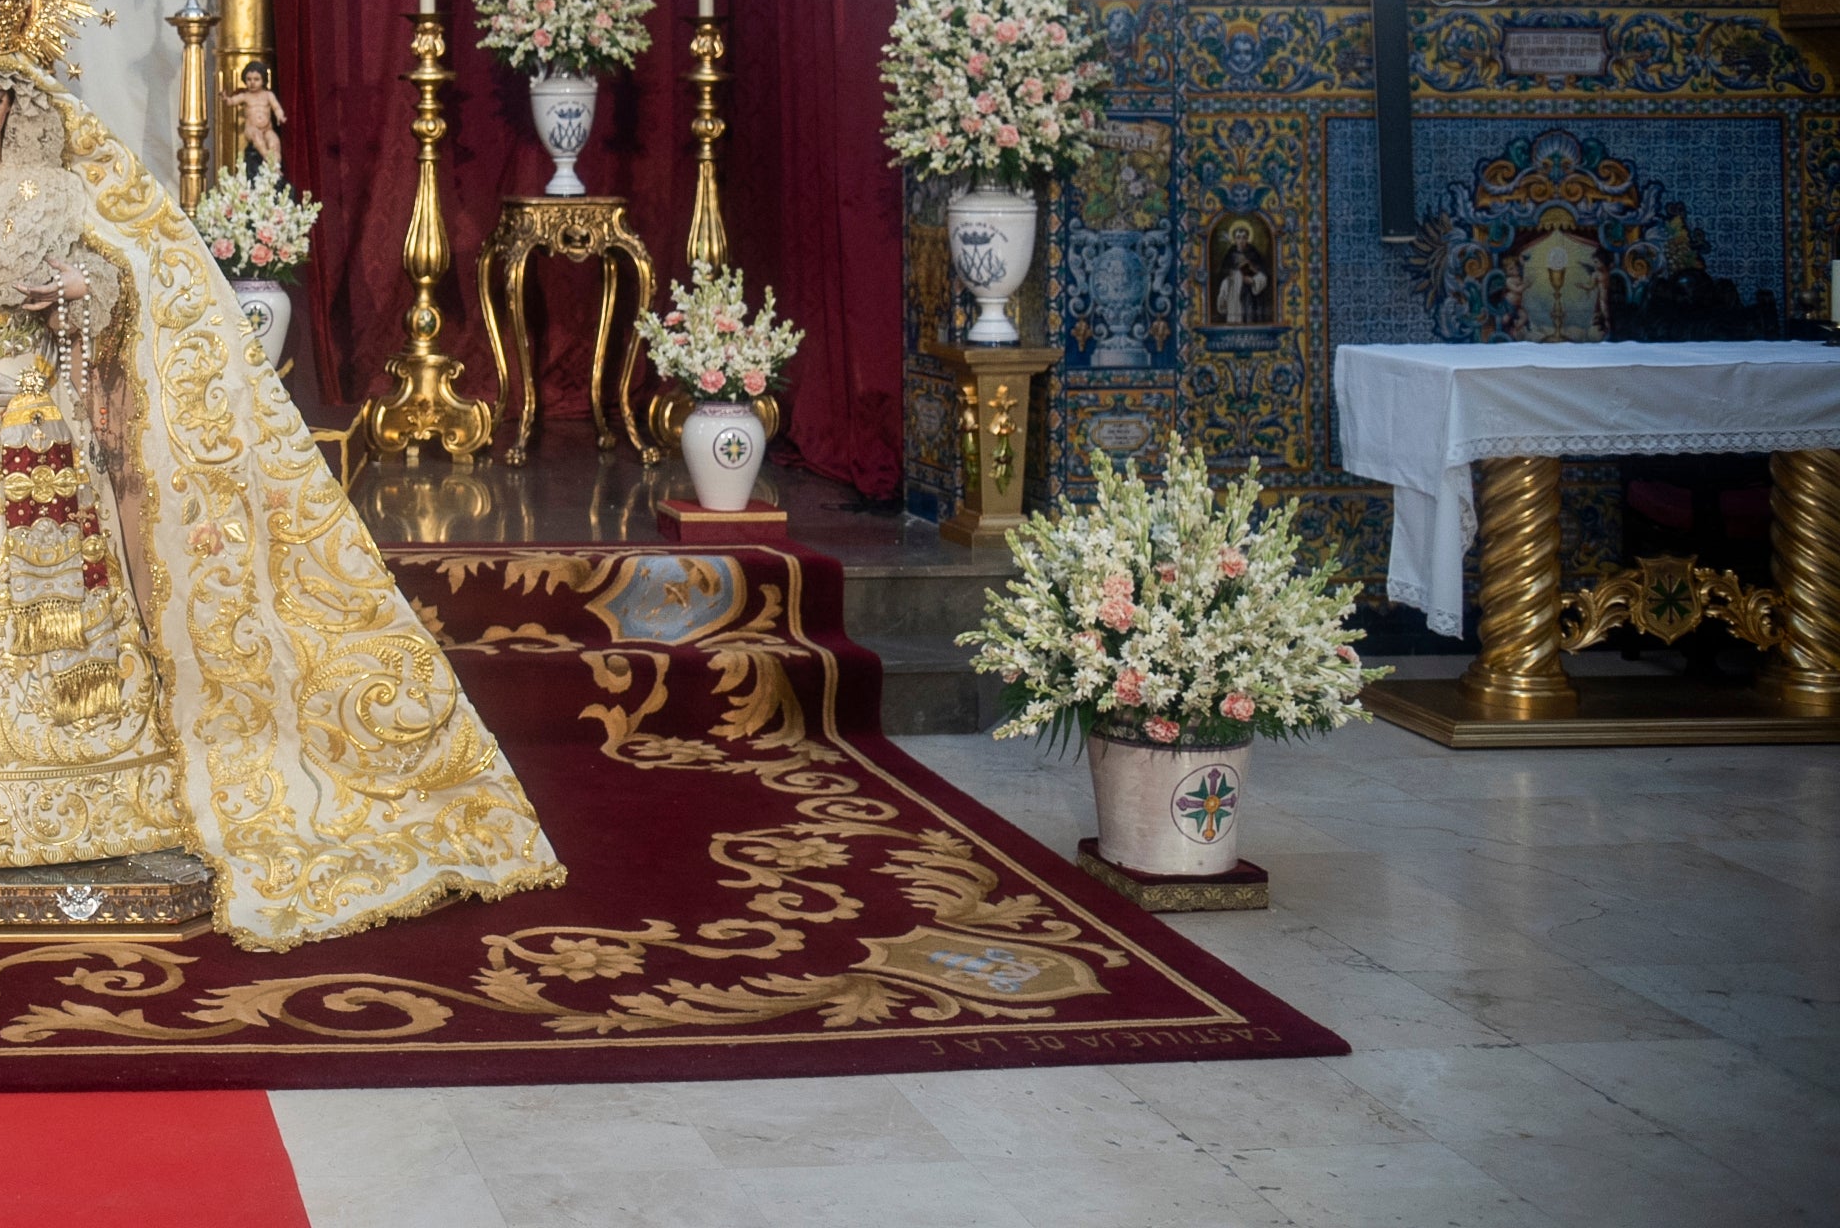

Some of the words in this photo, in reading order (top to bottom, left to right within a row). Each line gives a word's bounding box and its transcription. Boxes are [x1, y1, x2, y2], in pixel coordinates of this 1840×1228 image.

[953, 1035, 1009, 1054] LA
[1020, 1033, 1065, 1053] DE
[1077, 1026, 1282, 1049] CASTILLEJA
